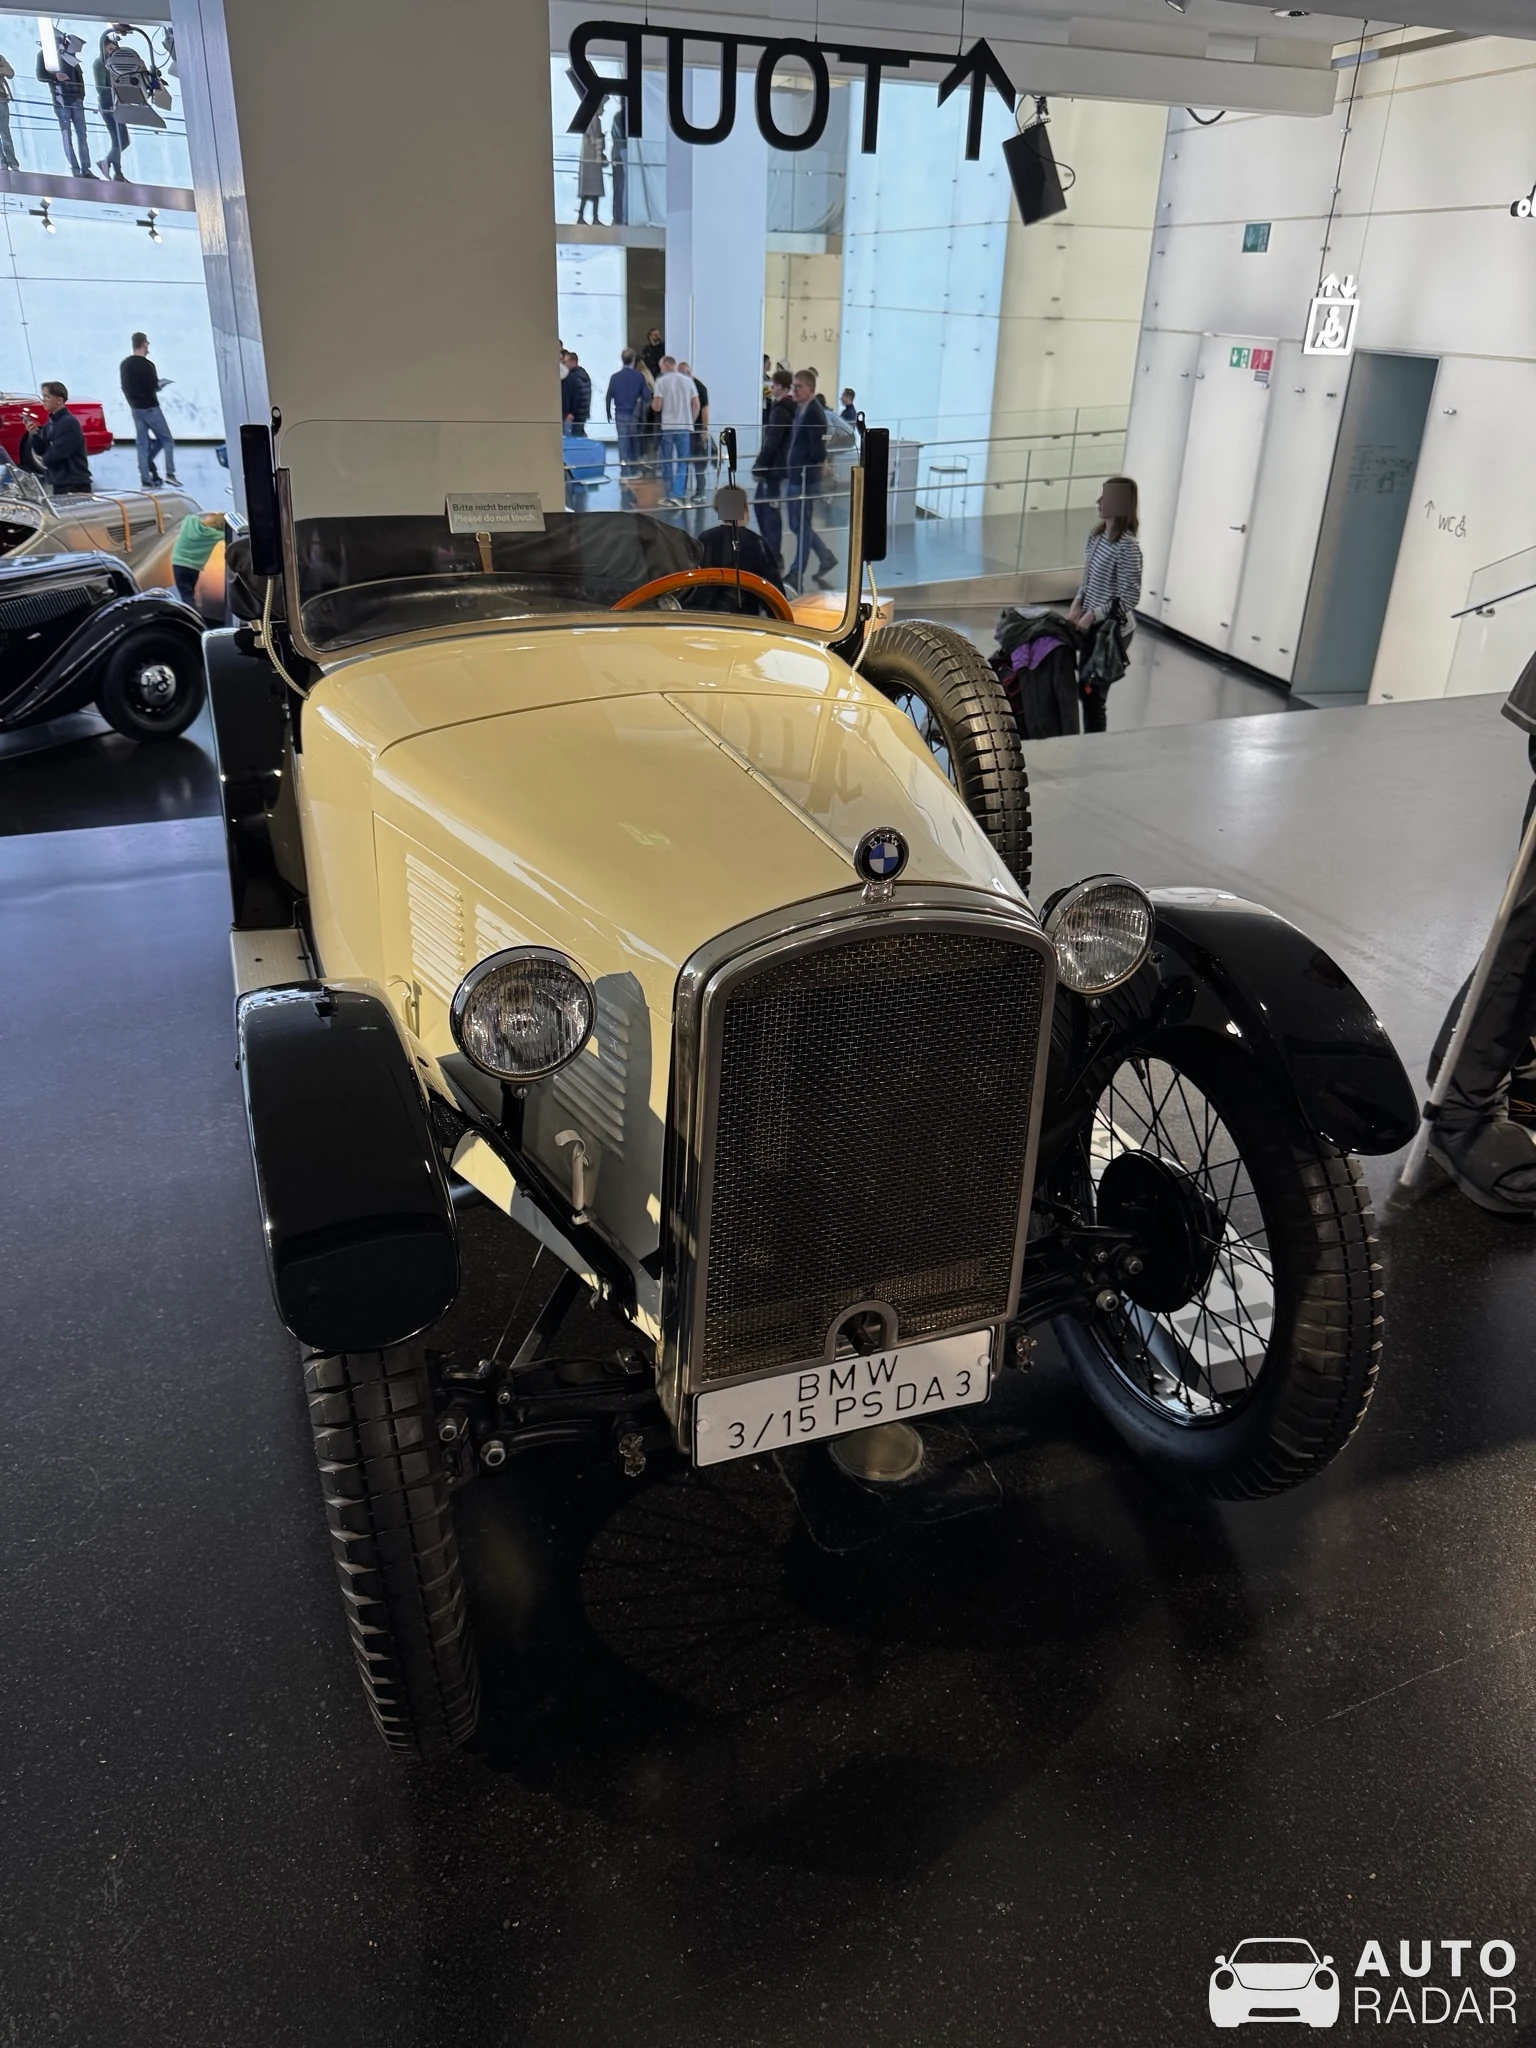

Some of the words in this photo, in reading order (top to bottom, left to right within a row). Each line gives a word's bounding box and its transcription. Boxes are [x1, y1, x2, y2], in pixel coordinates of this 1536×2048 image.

[452, 503, 474, 512] Bitte
[475, 503, 497, 511] nicht
[498, 503, 537, 511] berühren.
[454, 514, 482, 522] Please
[483, 514, 495, 522] do
[496, 514, 511, 522] not
[511, 513, 537, 521] touch.
[1438, 514, 1456, 532] WC
[867, 834, 901, 849] BMW
[798, 1354, 899, 1402] BMW
[728, 1405, 817, 1449] 3/15
